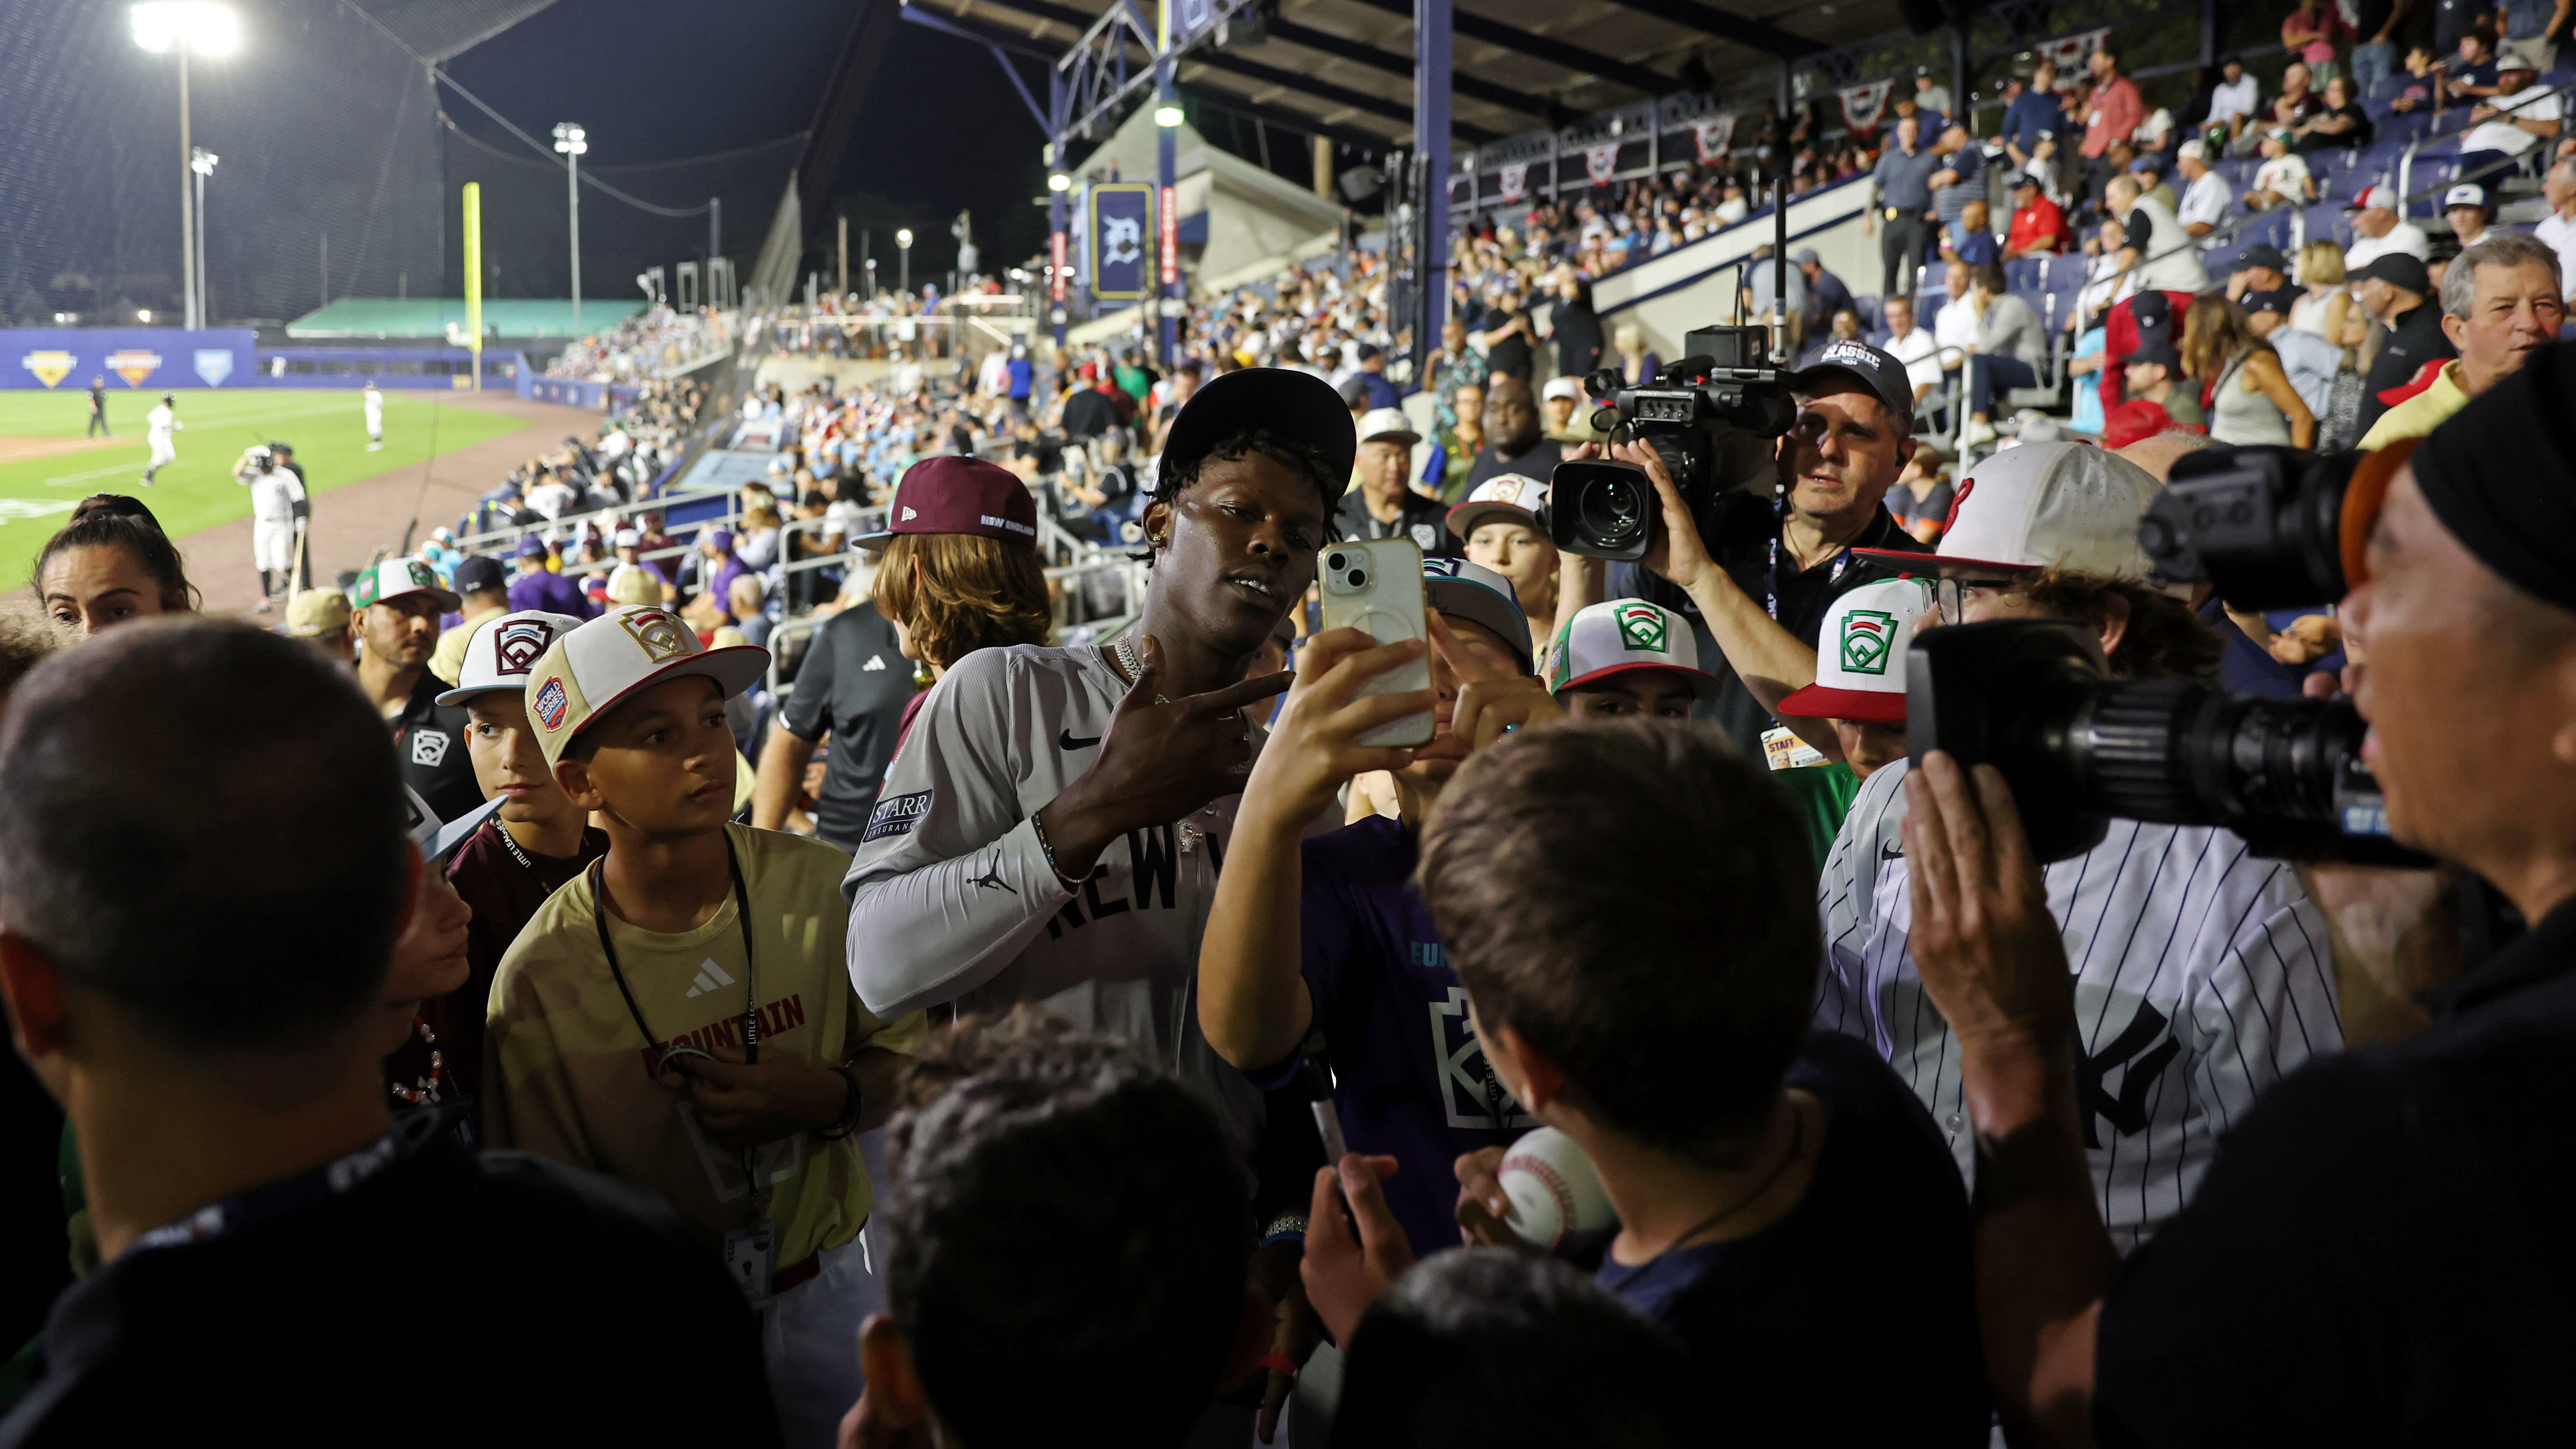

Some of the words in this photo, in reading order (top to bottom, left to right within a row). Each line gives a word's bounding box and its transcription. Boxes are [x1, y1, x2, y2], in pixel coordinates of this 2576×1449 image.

[980, 514, 1006, 528] NEW
[535, 681, 560, 712] WORLD
[540, 690, 564, 720] SERIES
[1769, 738, 1794, 752] STAFF
[873, 795, 928, 824] STARR
[512, 848, 531, 868] LITTLE
[748, 1019, 756, 1045] LITTLE
[1486, 1072, 1497, 1101] LITTLE
